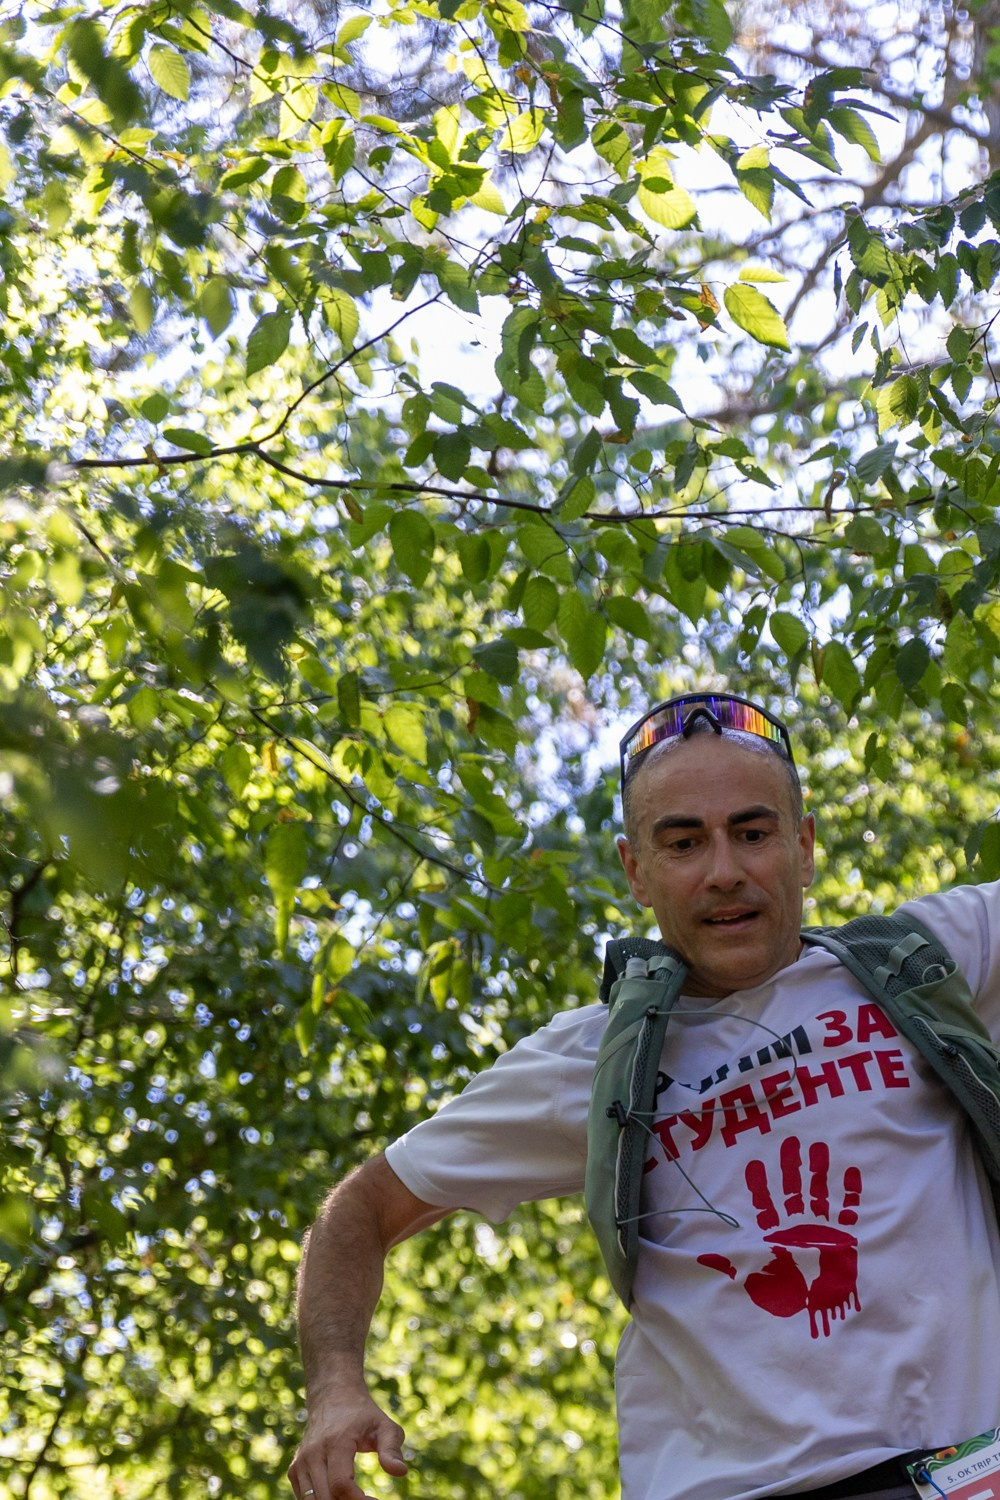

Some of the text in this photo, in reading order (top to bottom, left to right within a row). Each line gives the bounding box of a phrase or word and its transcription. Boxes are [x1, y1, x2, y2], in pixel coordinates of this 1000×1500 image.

[815, 1003, 899, 1047] ЗА
[957, 1467, 972, 1478] OK
[971, 1457, 991, 1472] TRIP
